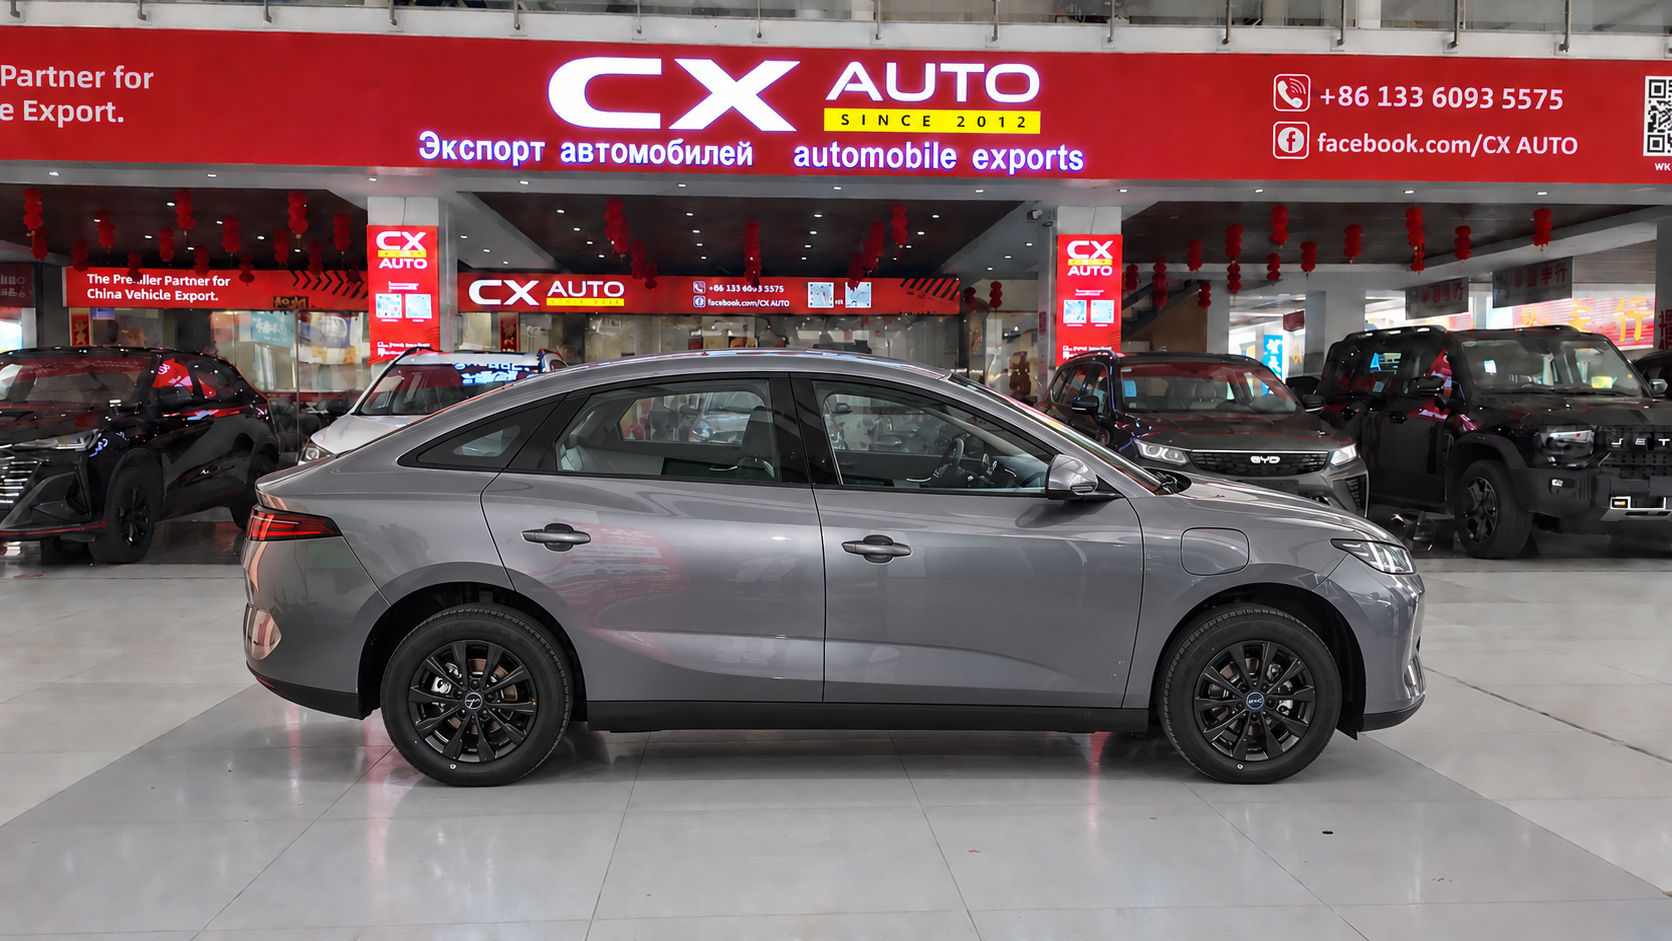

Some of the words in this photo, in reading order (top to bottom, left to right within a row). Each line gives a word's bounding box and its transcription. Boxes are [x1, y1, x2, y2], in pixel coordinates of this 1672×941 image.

[0, 64, 105, 88] Partner
[114, 65, 154, 89] for
[548, 56, 801, 132] CX
[825, 61, 1040, 103] AUTO
[1320, 85, 1370, 107] +86
[1377, 85, 1423, 107] 133
[1432, 86, 1494, 109] 6093
[1501, 88, 1563, 110] 5575
[23, 99, 124, 128] Export.
[841, 113, 931, 127] SINCE
[957, 115, 1026, 128] 2012
[418, 130, 546, 167] Экспорт
[560, 138, 753, 166] автомобилей
[793, 140, 958, 170] automobile
[972, 143, 1084, 175] exports
[1317, 132, 1511, 158] facebook.com/CX
[1516, 136, 1578, 155] AUTO
[376, 230, 427, 250] CX
[1066, 240, 1114, 259] CX
[378, 257, 428, 270] AUTO
[1067, 265, 1113, 277] AUTO
[87, 273, 110, 284] The
[164, 276, 210, 287] Partner
[212, 276, 231, 287] for
[468, 279, 540, 306] CX
[547, 280, 625, 298] AUTO
[86, 288, 122, 300] China
[125, 289, 171, 300] Vehicle
[174, 290, 219, 303] Export.
